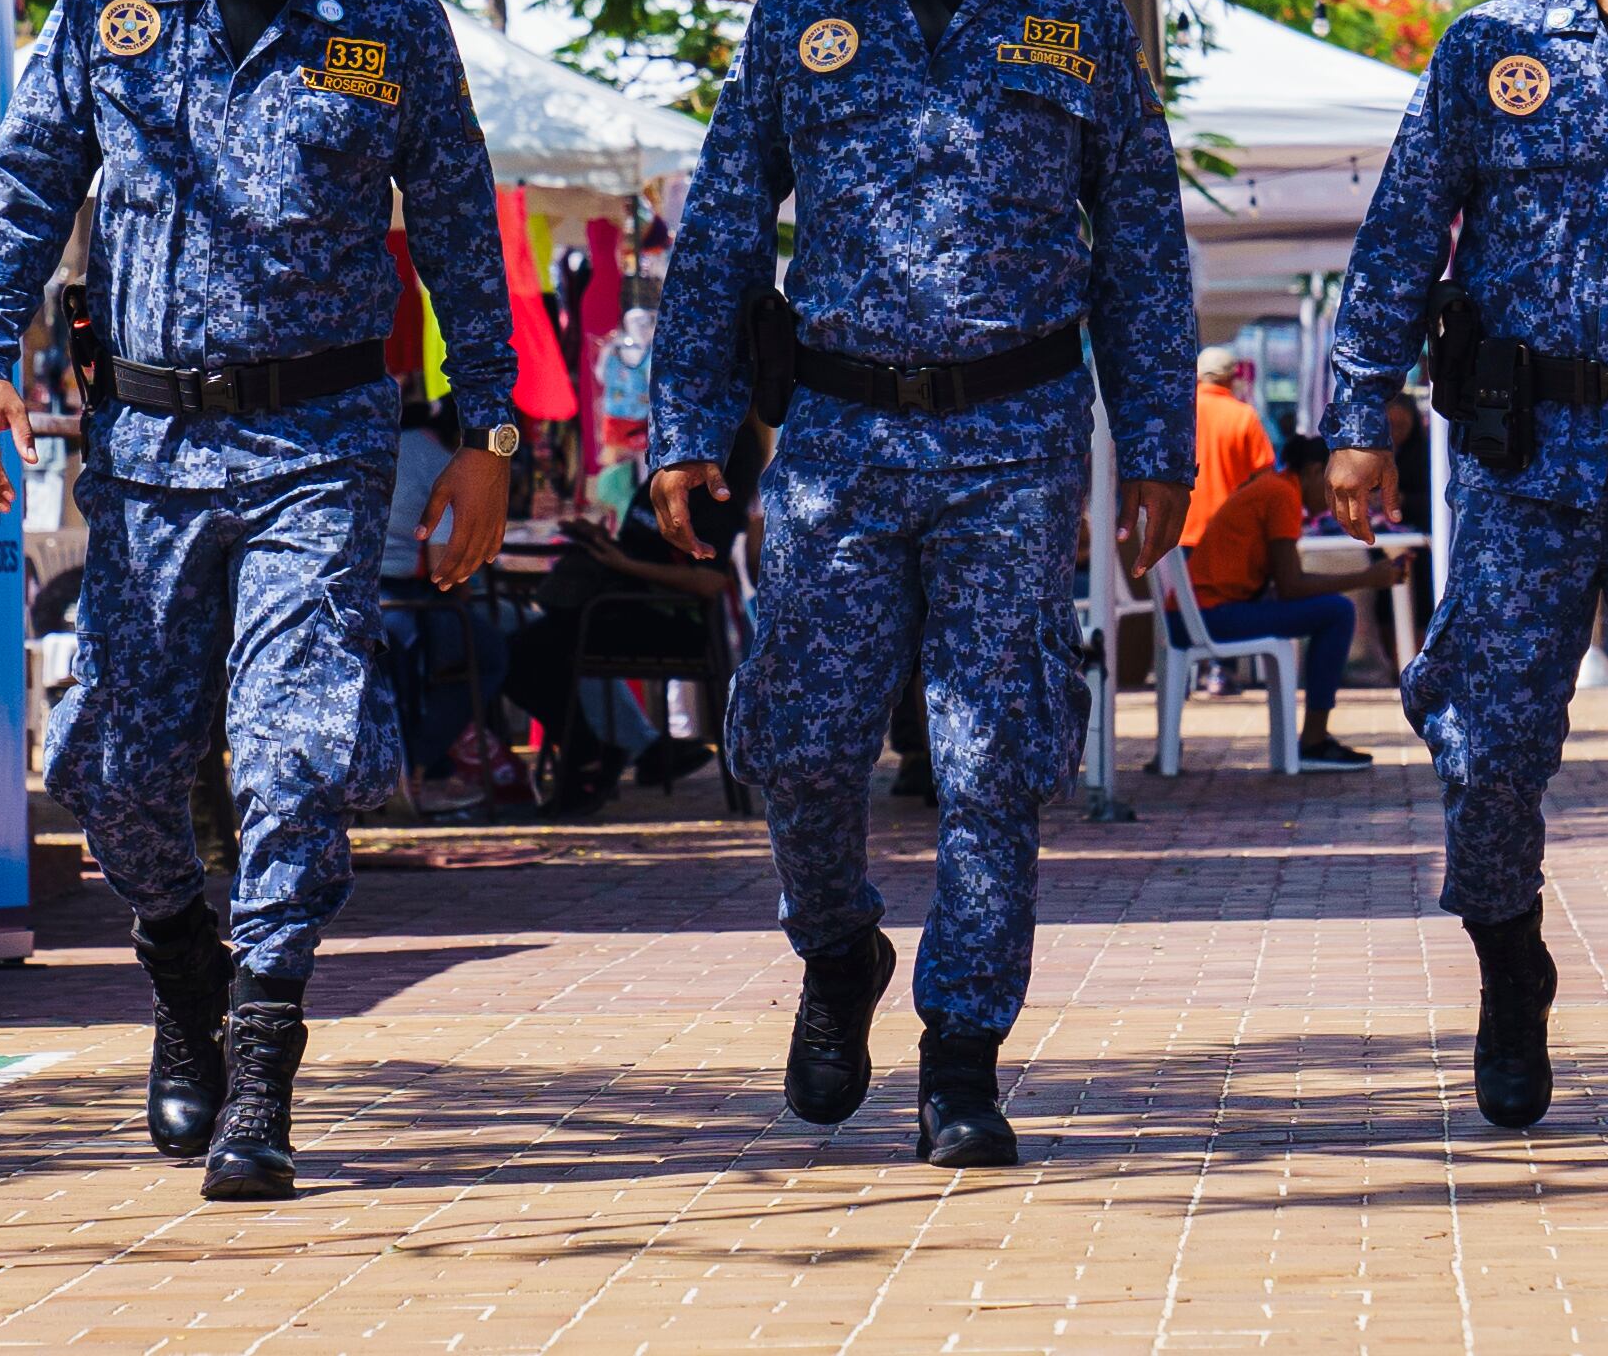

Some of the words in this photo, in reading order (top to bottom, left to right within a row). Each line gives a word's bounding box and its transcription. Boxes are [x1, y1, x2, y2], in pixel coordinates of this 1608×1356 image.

[1029, 23, 1073, 44] 327
[332, 44, 380, 71] 339
[1030, 50, 1067, 67] GOMEZ
[323, 75, 376, 95] ROSERO
[381, 85, 393, 100] M.
